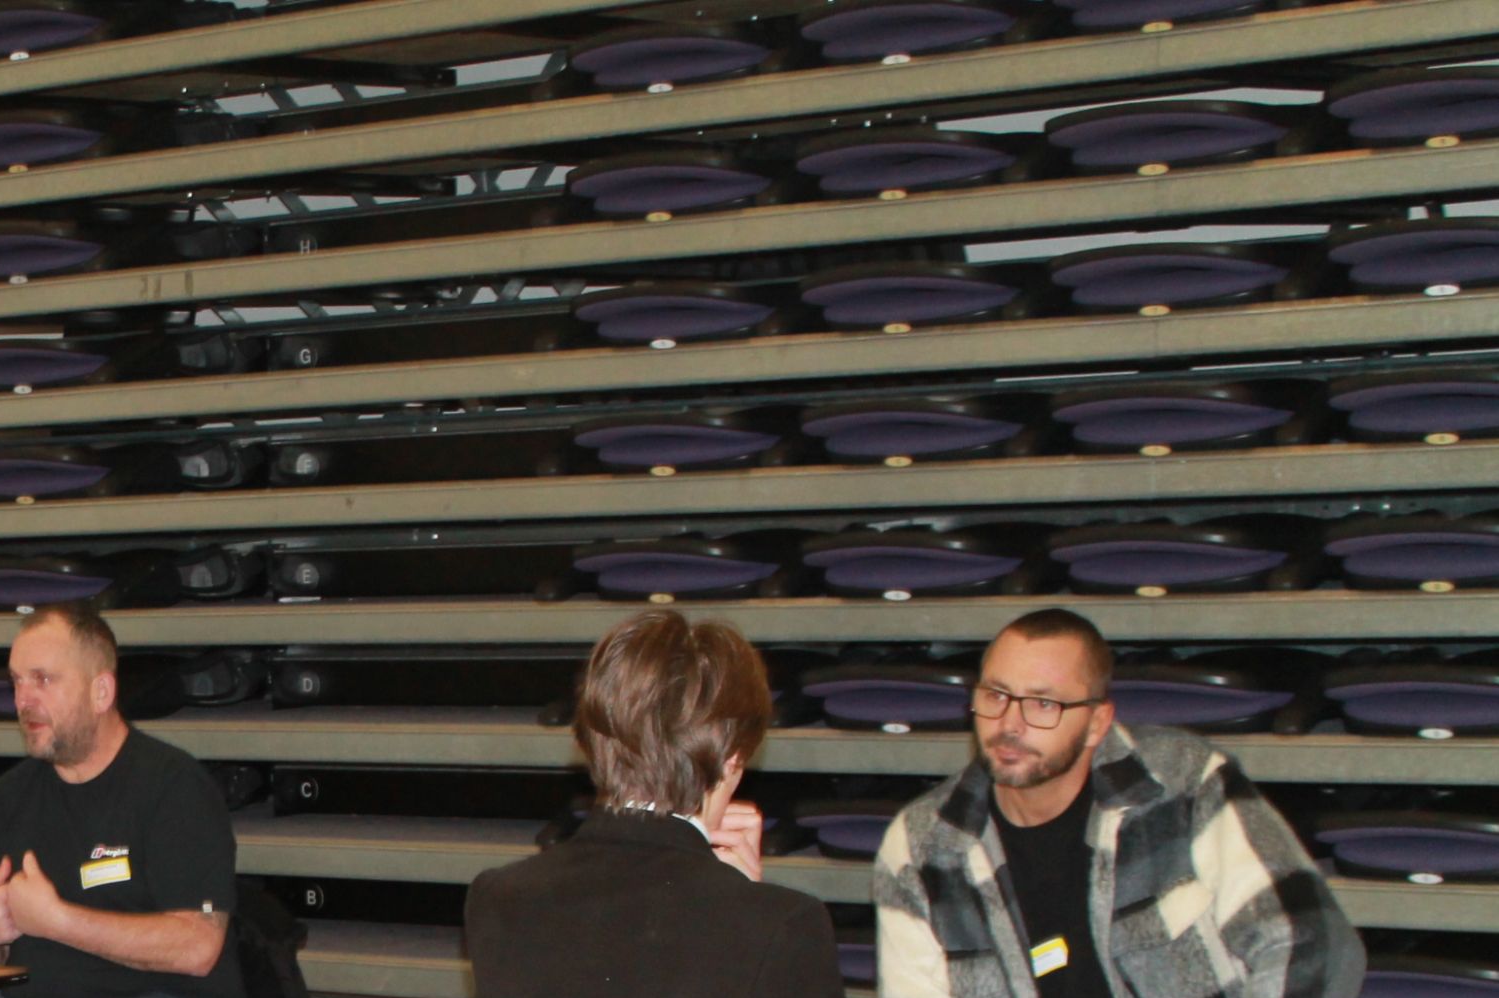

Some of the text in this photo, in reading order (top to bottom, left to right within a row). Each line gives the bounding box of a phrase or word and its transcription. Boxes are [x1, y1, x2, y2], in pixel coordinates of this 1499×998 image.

[299, 239, 311, 255] H
[300, 348, 312, 364] G
[301, 569, 311, 584] E
[302, 678, 313, 693] D
[300, 782, 311, 797] C
[306, 890, 317, 905] B
